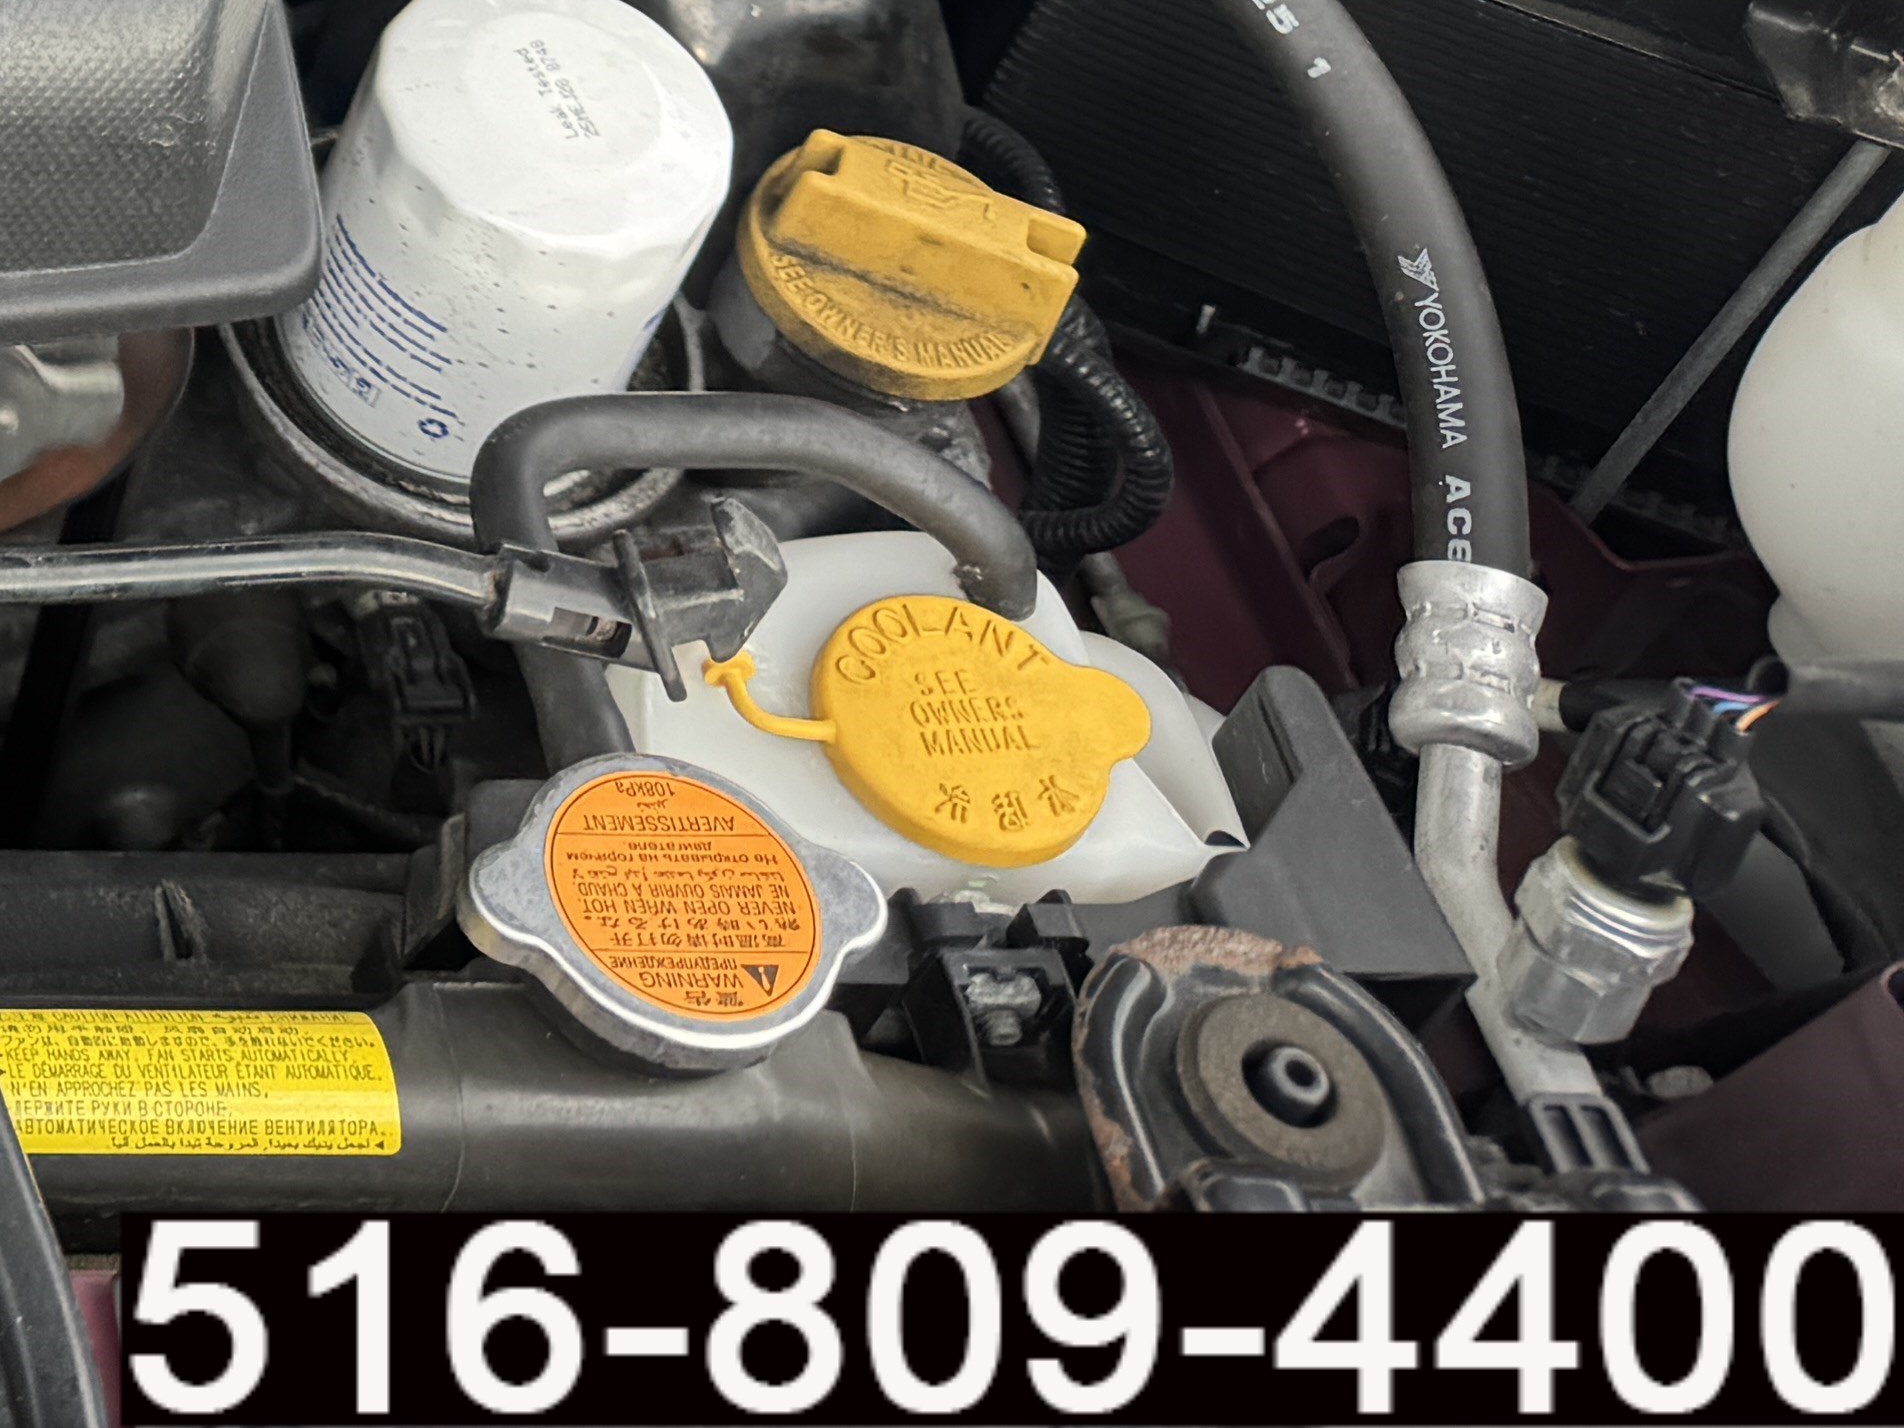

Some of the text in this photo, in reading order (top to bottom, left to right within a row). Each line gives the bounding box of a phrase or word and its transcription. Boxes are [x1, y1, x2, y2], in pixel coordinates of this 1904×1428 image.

[771, 254, 813, 295] SEE
[913, 332, 1011, 367] MANUAL
[1414, 293, 1468, 448] YOKOHAMA
[835, 604, 1050, 684] COOLANT
[915, 668, 977, 696] SEE
[909, 696, 1025, 728] OWNERS
[920, 725, 1042, 757] MANUAL
[615, 781, 674, 797] 108kPa
[583, 815, 735, 831] AVERTISSEMENT
[649, 883, 704, 898] OUVRIR
[710, 883, 762, 898] JAMAIS
[769, 883, 790, 898] NE
[624, 899, 677, 914] WHEN
[683, 899, 730, 915] OPEN
[737, 899, 796, 915] NEVER
[639, 971, 743, 989] WARNING
[6, 1050, 39, 1061] KEEP
[47, 1049, 90, 1062] HANDS
[148, 1050, 174, 1062] FAN
[183, 1049, 235, 1062] STARTS
[9, 1064, 25, 1078] LE
[114, 1065, 131, 1078] DU
[139, 1064, 228, 1079] VENTILATEUR
[10, 1082, 47, 1097] N'EN
[56, 1081, 135, 1097] APPROCHEZ
[145, 1082, 172, 1097] PAS
[180, 1082, 207, 1097] LES
[92, 1101, 132, 1117] РУКИ
[139, 1102, 148, 1117] В
[165, 1120, 258, 1135] ВКЛЮЧЕНИЕ
